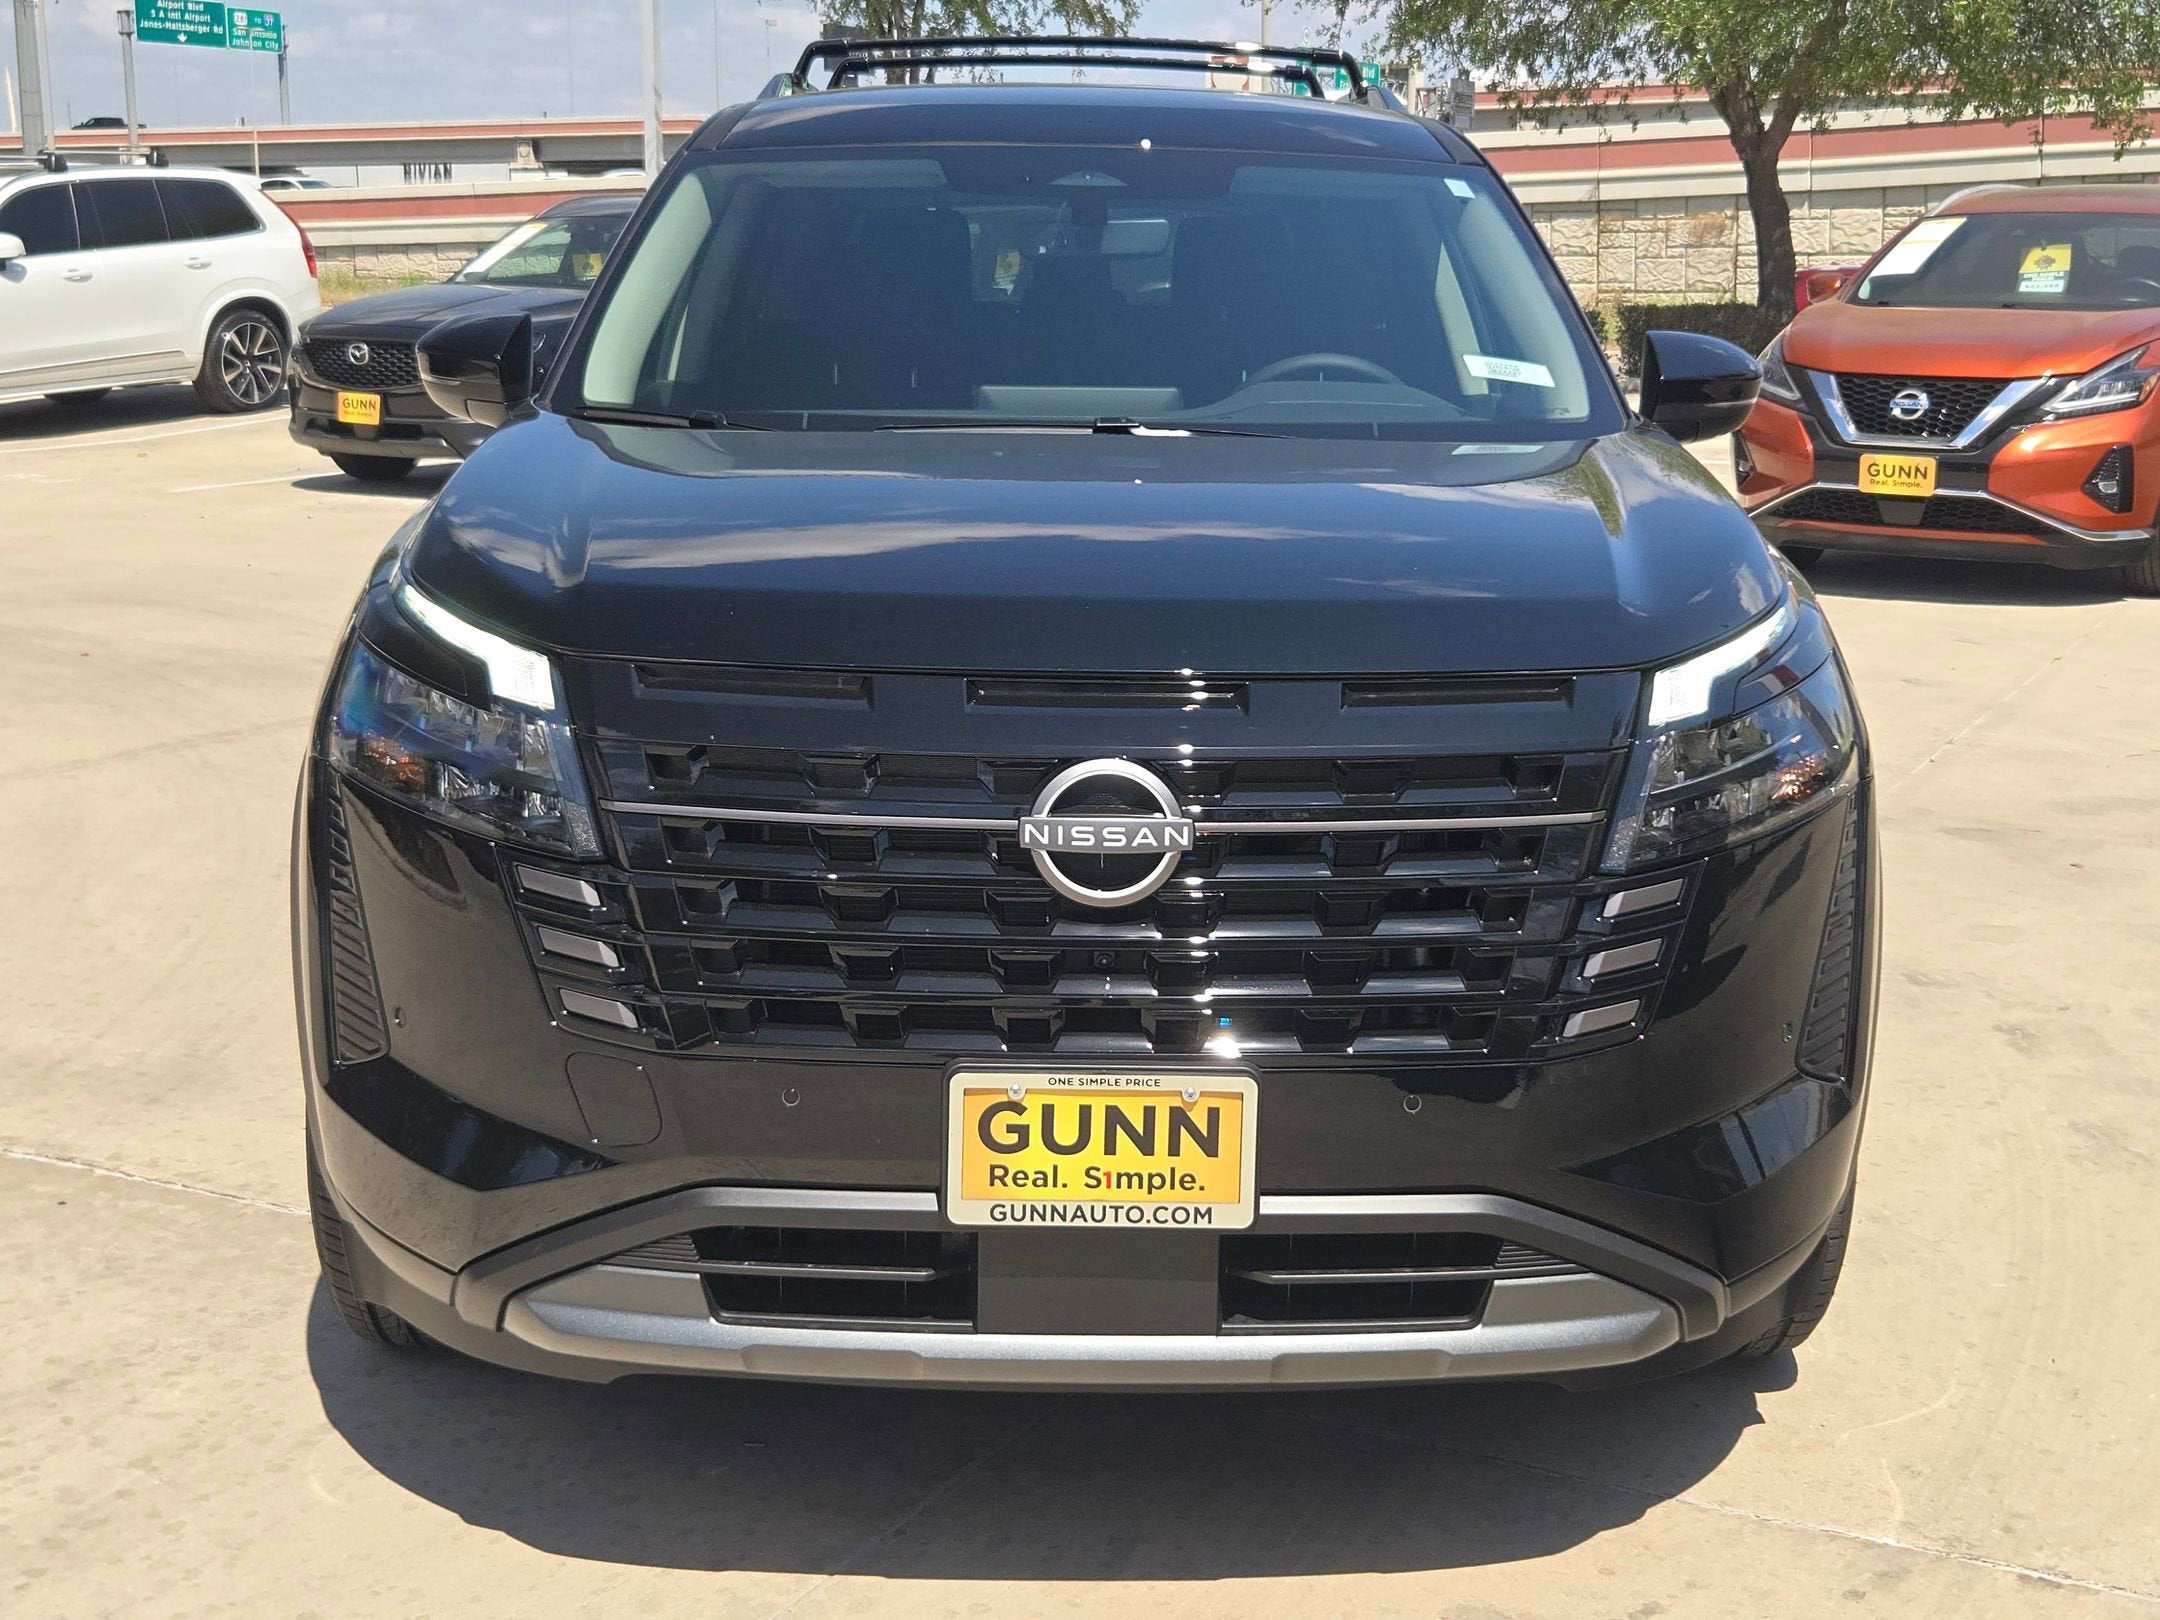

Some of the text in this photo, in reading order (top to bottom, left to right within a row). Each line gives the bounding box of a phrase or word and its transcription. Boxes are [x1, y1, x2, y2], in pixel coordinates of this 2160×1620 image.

[187, 2, 204, 11] Blvd
[158, 9, 165, 18] A
[184, 12, 211, 22] Airport
[139, 19, 223, 34] Jones-Maltsberger Rd
[232, 37, 279, 51] Johnon City
[403, 162, 452, 183] RIVIAN
[342, 397, 377, 411] GUNN
[1867, 462, 1928, 480] GUNN
[1869, 478, 1890, 487] Real.
[1023, 823, 1190, 847] NISSAN
[1047, 1077, 1161, 1088] ONE SIMPLE PRICE
[977, 1100, 1220, 1158] GUNN
[988, 1164, 1068, 1189] Real.
[989, 1204, 1212, 1225] GUNNAUTO.COM
